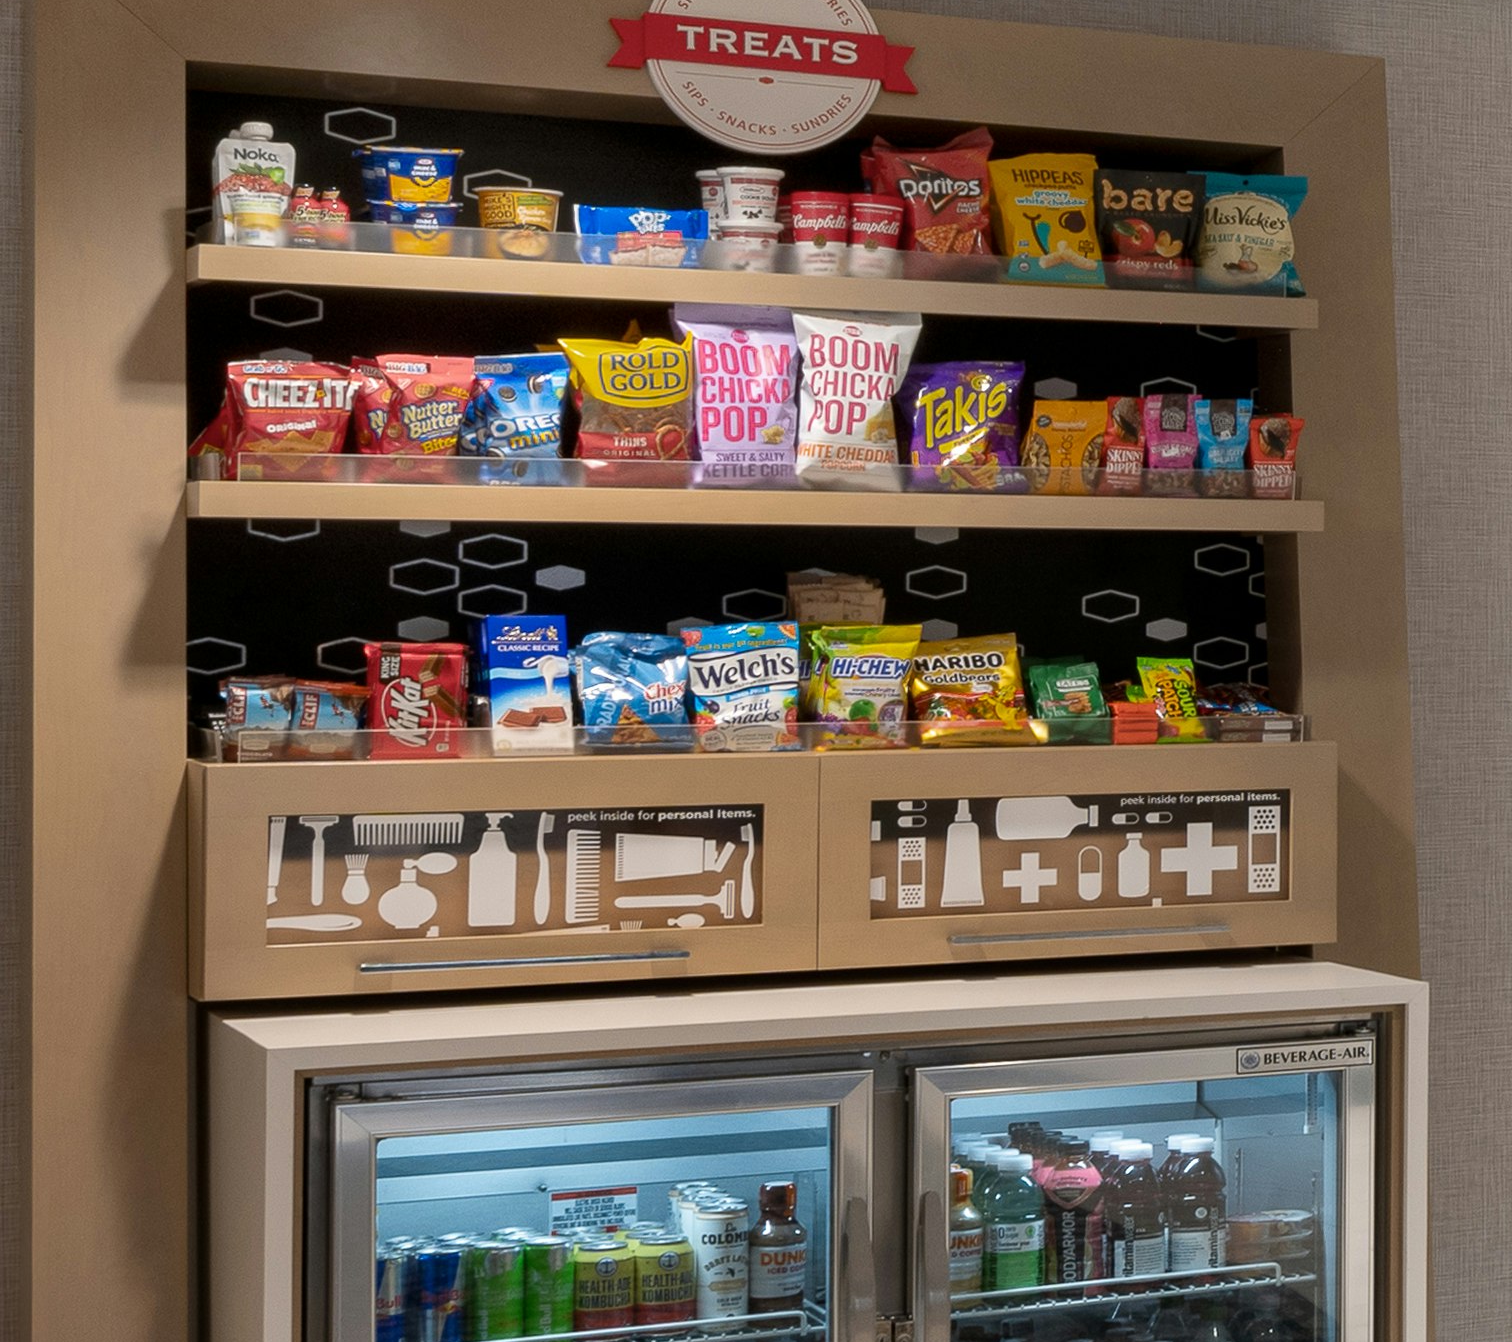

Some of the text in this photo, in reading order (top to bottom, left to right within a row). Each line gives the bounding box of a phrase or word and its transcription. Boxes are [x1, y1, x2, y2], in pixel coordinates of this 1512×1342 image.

[676, 23, 858, 65] TREATS
[682, 80, 852, 136] SIPS SNACKS SUNDRIES
[1012, 168, 1084, 186] HIPPEAS
[899, 177, 982, 202] Doritos
[1102, 179, 1194, 212] bare
[1233, 205, 1287, 235] Vickie's
[1161, 258, 1179, 270] reds
[610, 351, 680, 371] ROLD
[698, 339, 791, 377] BOOM
[809, 333, 899, 376] BOOM
[610, 372, 681, 391] GOLD
[701, 375, 790, 404] CHICKA
[810, 369, 895, 402] CHICKA
[402, 401, 458, 424] Nutter
[701, 405, 768, 443] POP
[807, 399, 867, 436] POP
[916, 381, 1007, 449] Takis
[409, 413, 463, 439] Butter
[603, 449, 656, 457] ORIGINAL
[614, 436, 648, 447] THINS
[716, 452, 786, 463] SWEET & SALTY
[702, 463, 760, 479] KETTLE
[497, 644, 559, 652] CLASSIC RECIPE
[381, 655, 391, 679] KING
[390, 655, 400, 677] SIZE
[694, 653, 795, 689] Welch's
[832, 657, 912, 678] HI-CHEW
[914, 653, 1004, 673] HARIBO
[645, 681, 686, 700] Chex
[924, 673, 1000, 686] Goldbears
[651, 697, 682, 713] mix
[733, 699, 771, 714] Fruit
[1159, 680, 1183, 718] PATCH
[1174, 679, 1197, 718] SOUR
[719, 707, 781, 730] Snacks
[1120, 791, 1281, 807] peek inside for personal items.
[567, 811, 597, 823] peek
[600, 810, 635, 821] inside
[638, 810, 656, 820] for
[658, 808, 714, 822] personal
[1263, 1046, 1368, 1065] BEVERAGE-AIR
[1063, 1211, 1076, 1284] ODYARMOR
